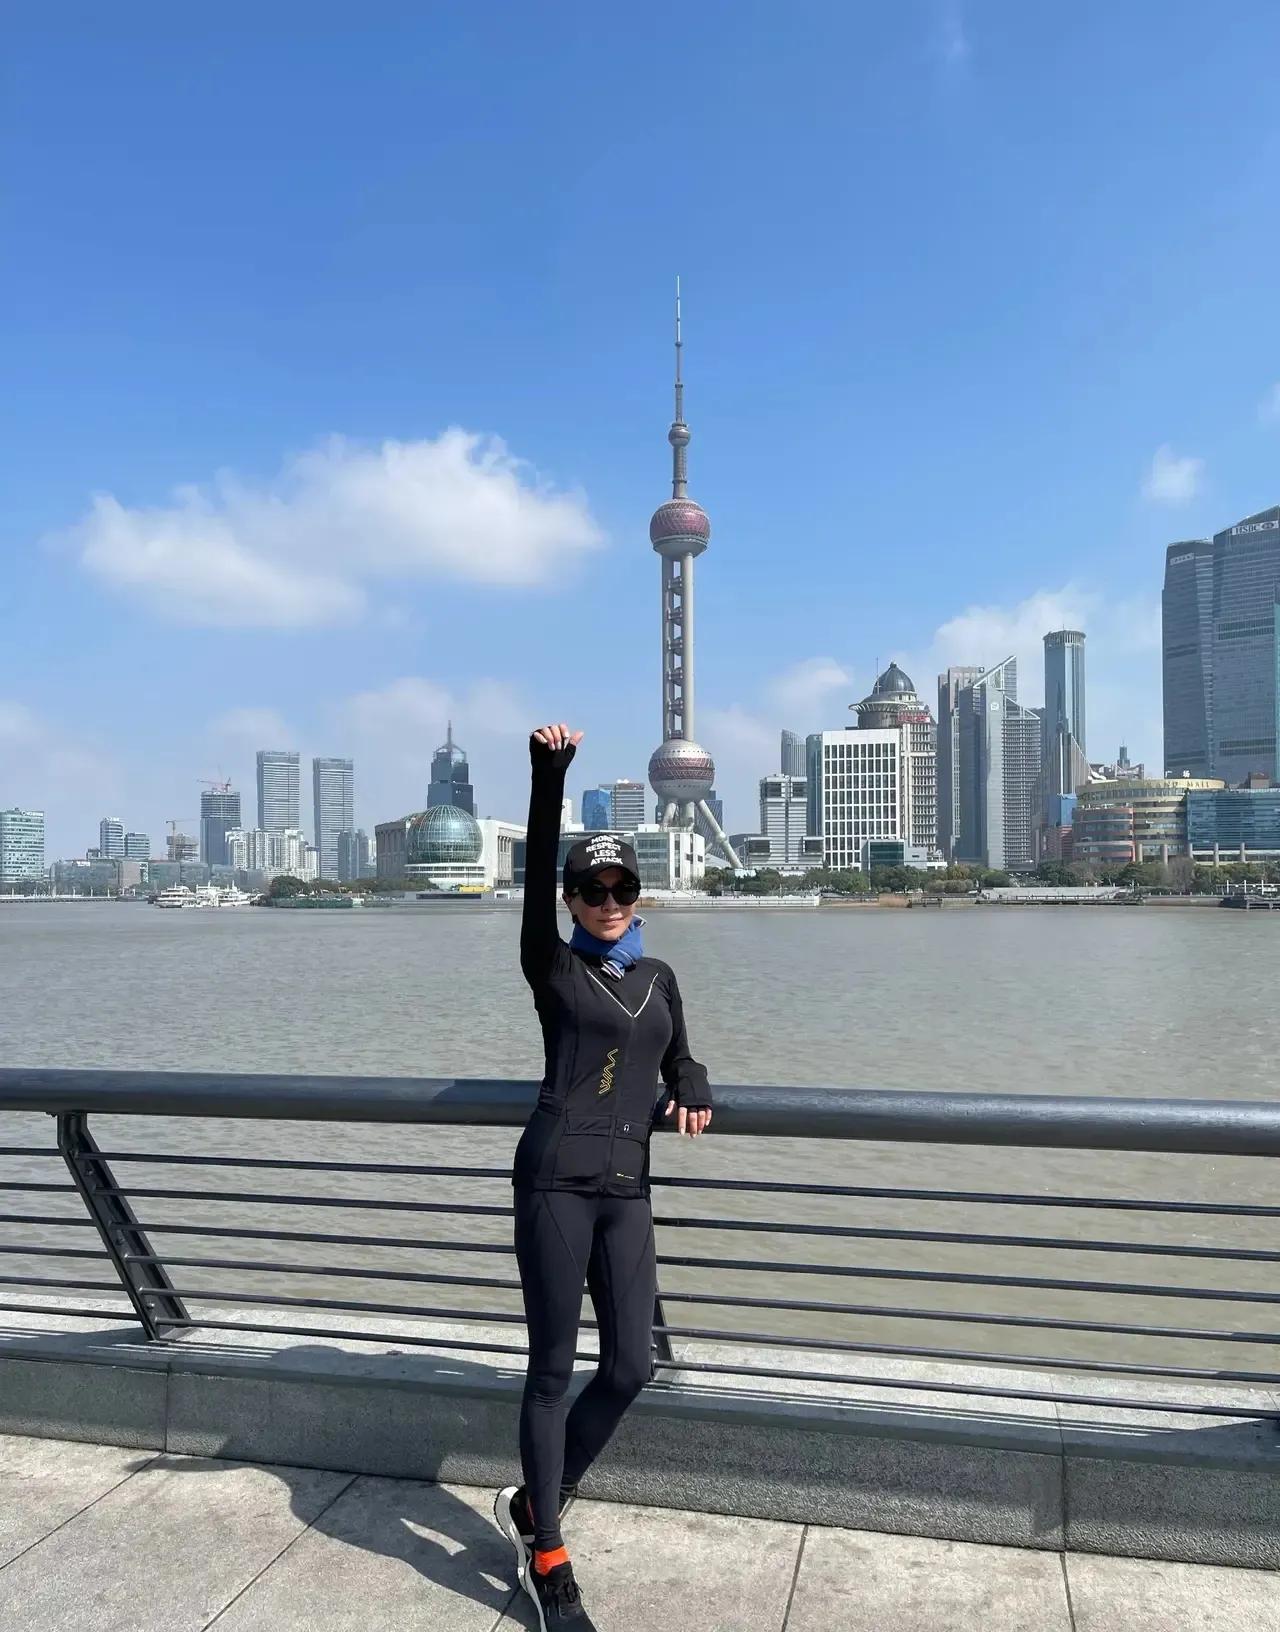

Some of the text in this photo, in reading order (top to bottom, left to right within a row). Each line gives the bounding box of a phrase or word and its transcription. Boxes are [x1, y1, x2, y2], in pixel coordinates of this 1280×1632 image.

[591, 835, 614, 844] MORE
[586, 842, 621, 852] RESPECT
[590, 857, 623, 866] ATTACK
